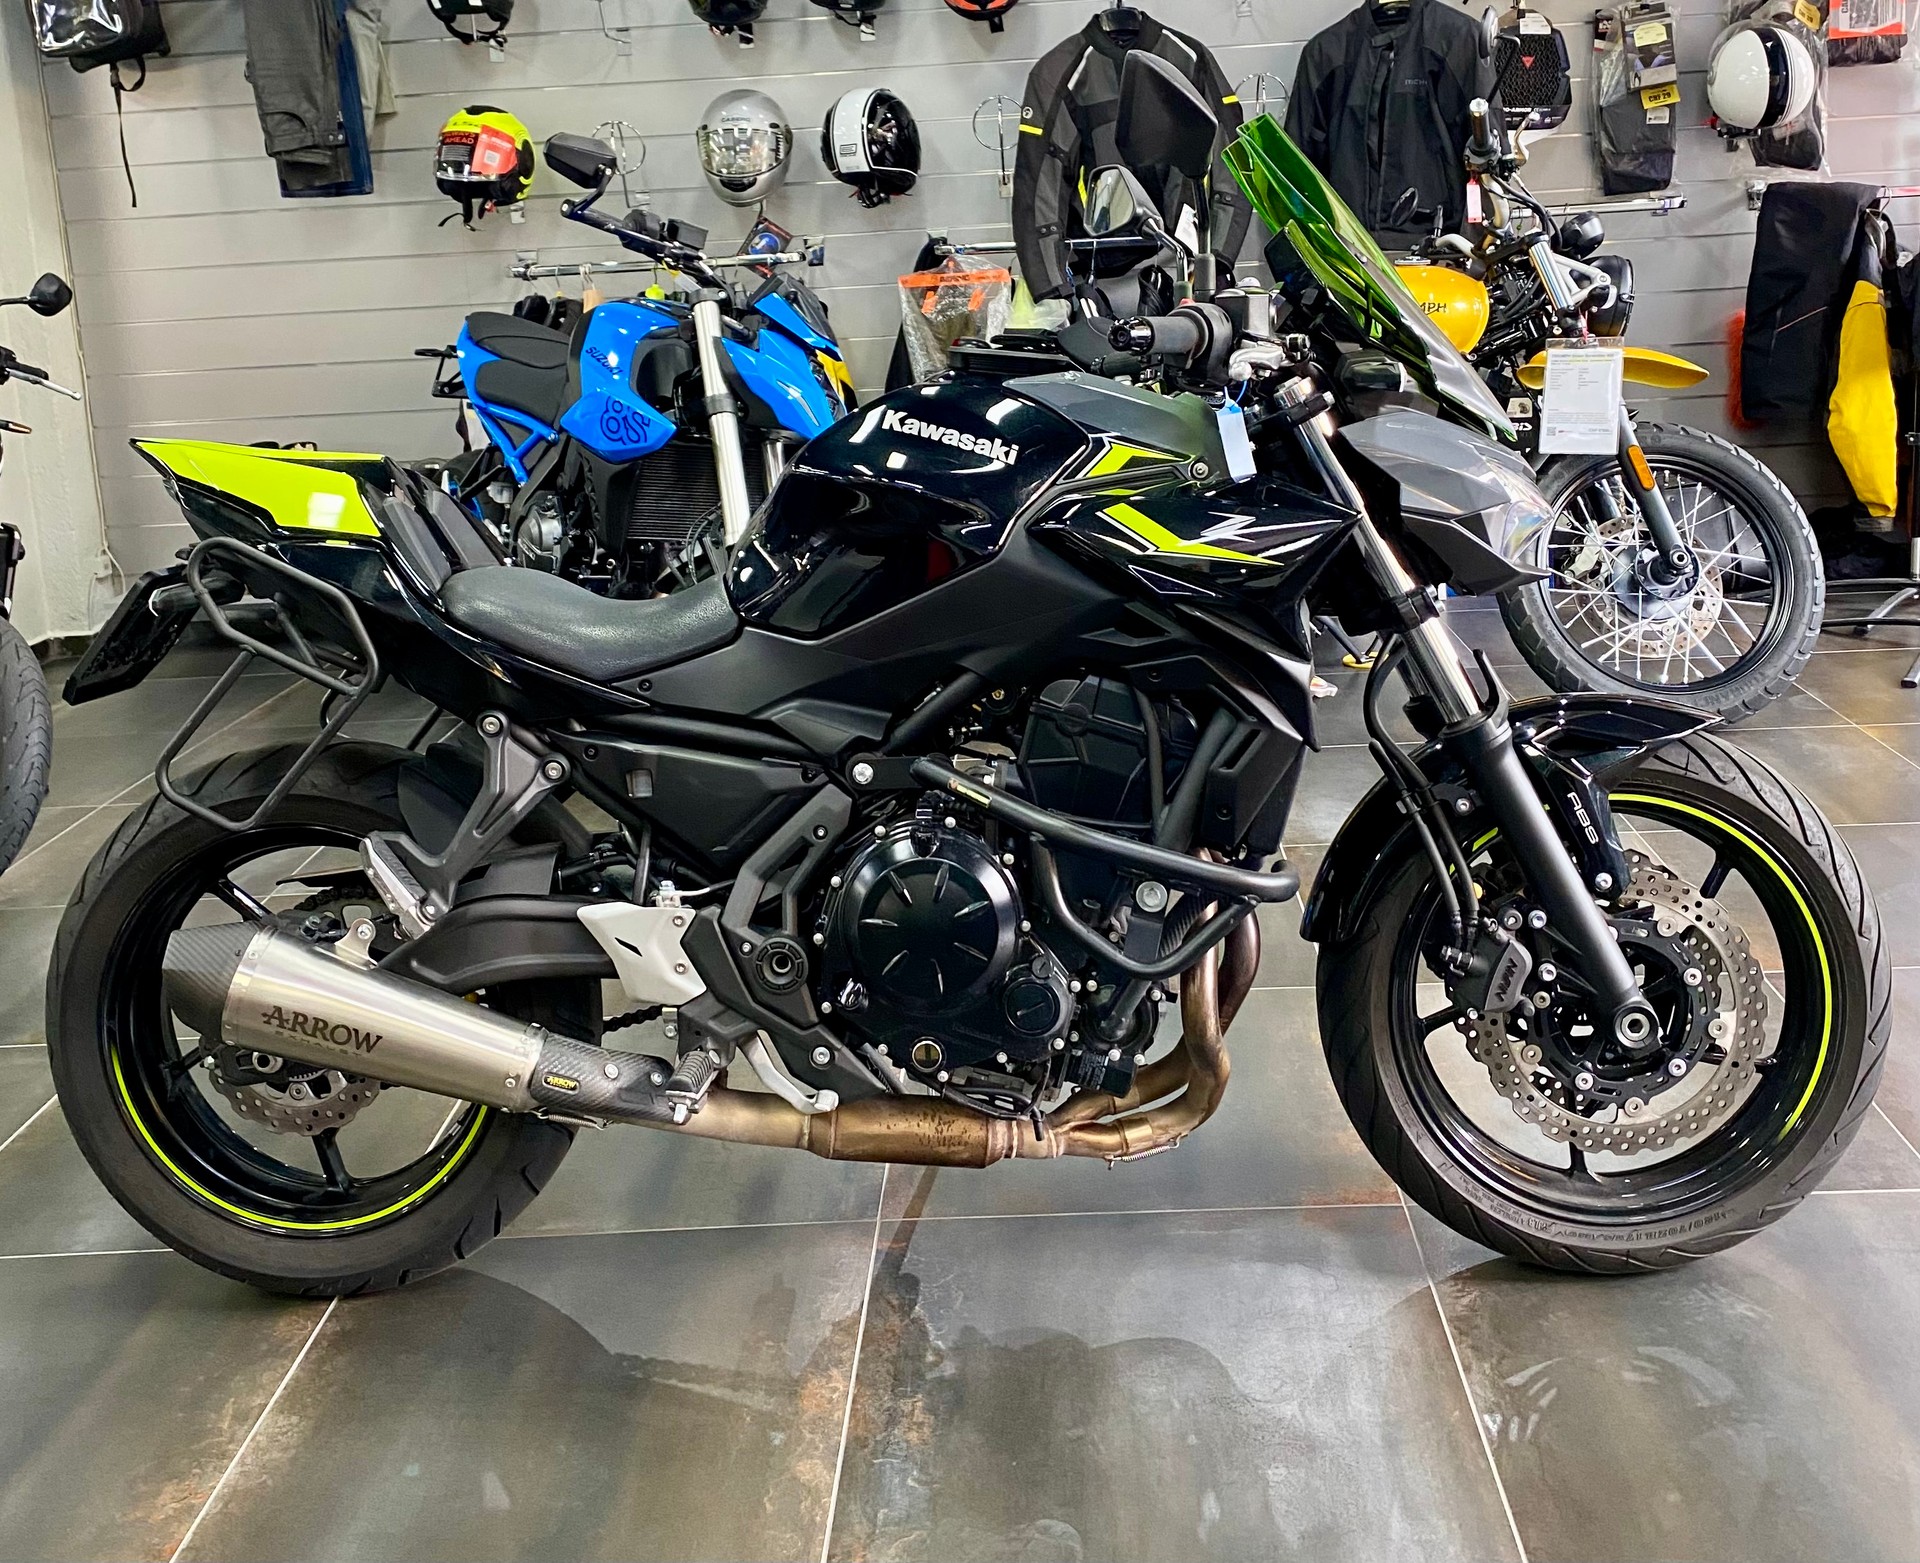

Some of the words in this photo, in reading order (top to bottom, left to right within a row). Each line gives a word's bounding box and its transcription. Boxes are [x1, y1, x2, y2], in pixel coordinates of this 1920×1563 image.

[881, 409, 1020, 466] Kawasaki
[1566, 791, 1600, 845] ABS
[260, 1005, 383, 1055] ARROW
